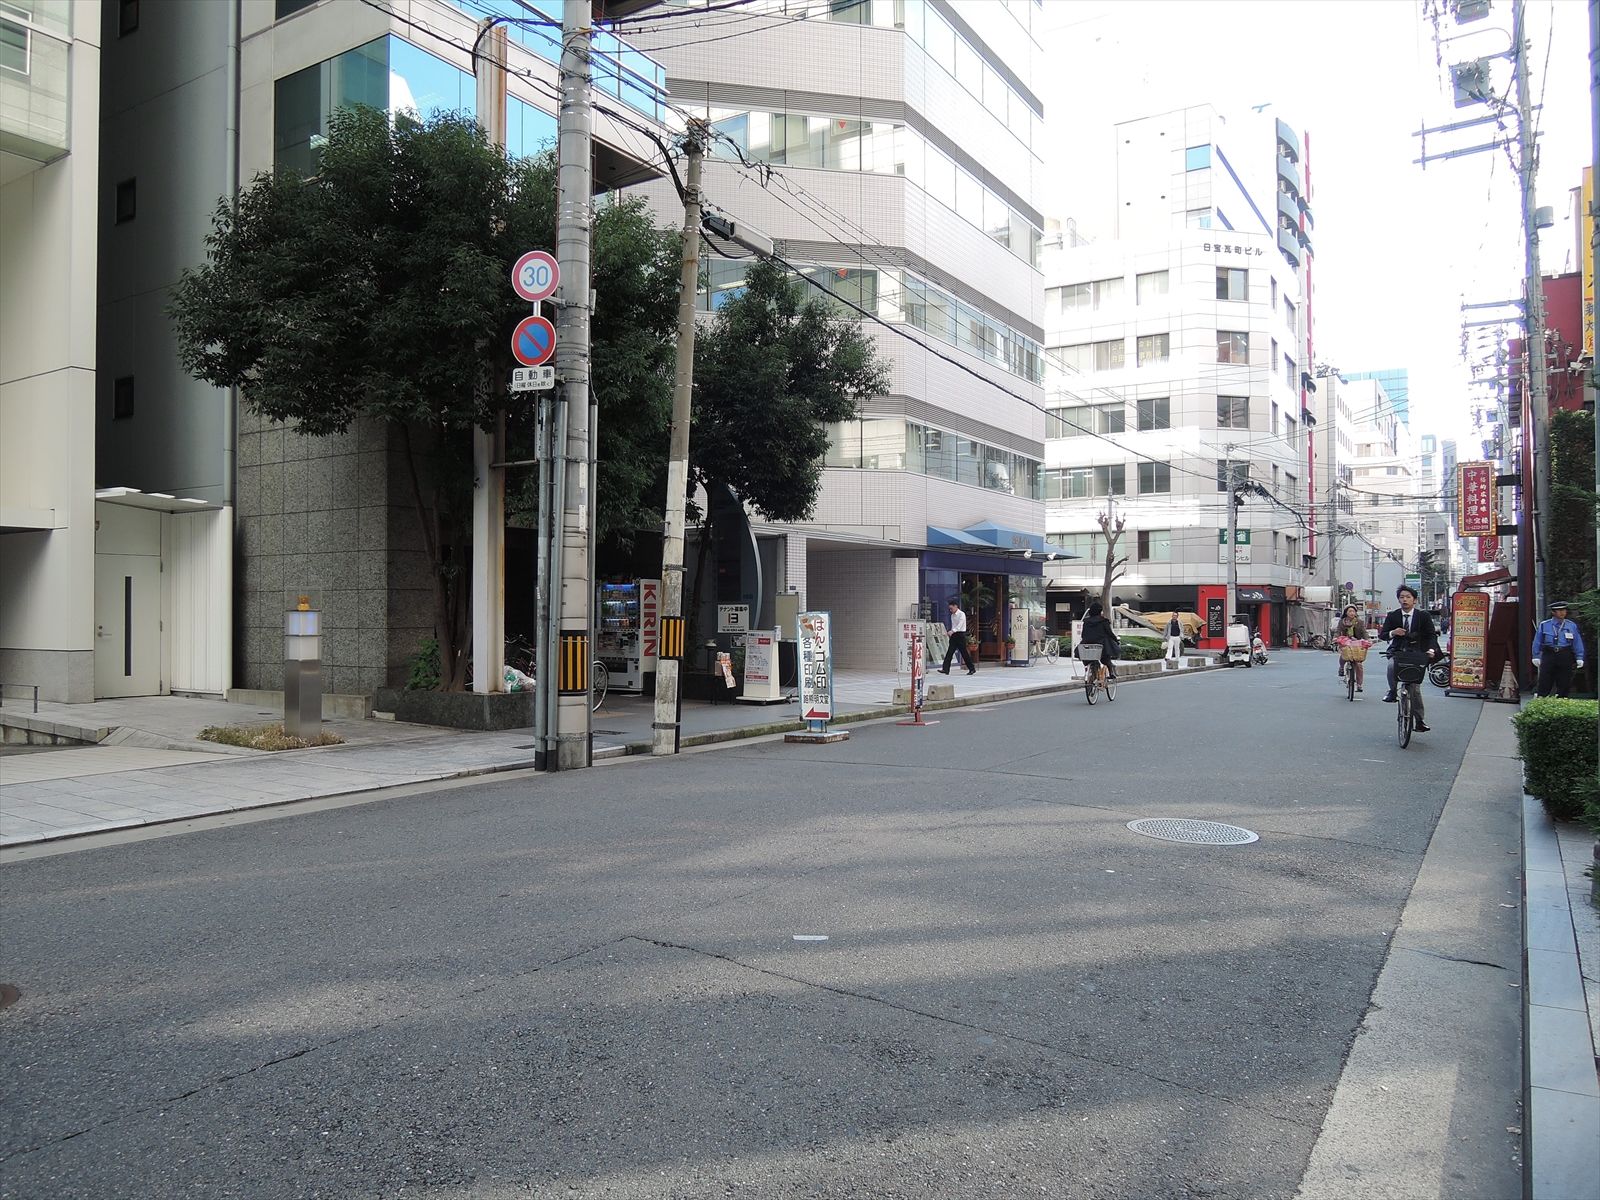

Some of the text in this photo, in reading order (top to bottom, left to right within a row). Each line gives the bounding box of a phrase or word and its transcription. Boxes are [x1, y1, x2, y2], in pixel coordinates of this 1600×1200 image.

[1203, 243, 1263, 256] 日宝瓦町ビル
[524, 266, 549, 287] 30
[515, 369, 552, 381] 自動車
[1466, 470, 1479, 516] 中華料理
[643, 583, 657, 657] KIRIN
[802, 637, 814, 689] 各種印刷
